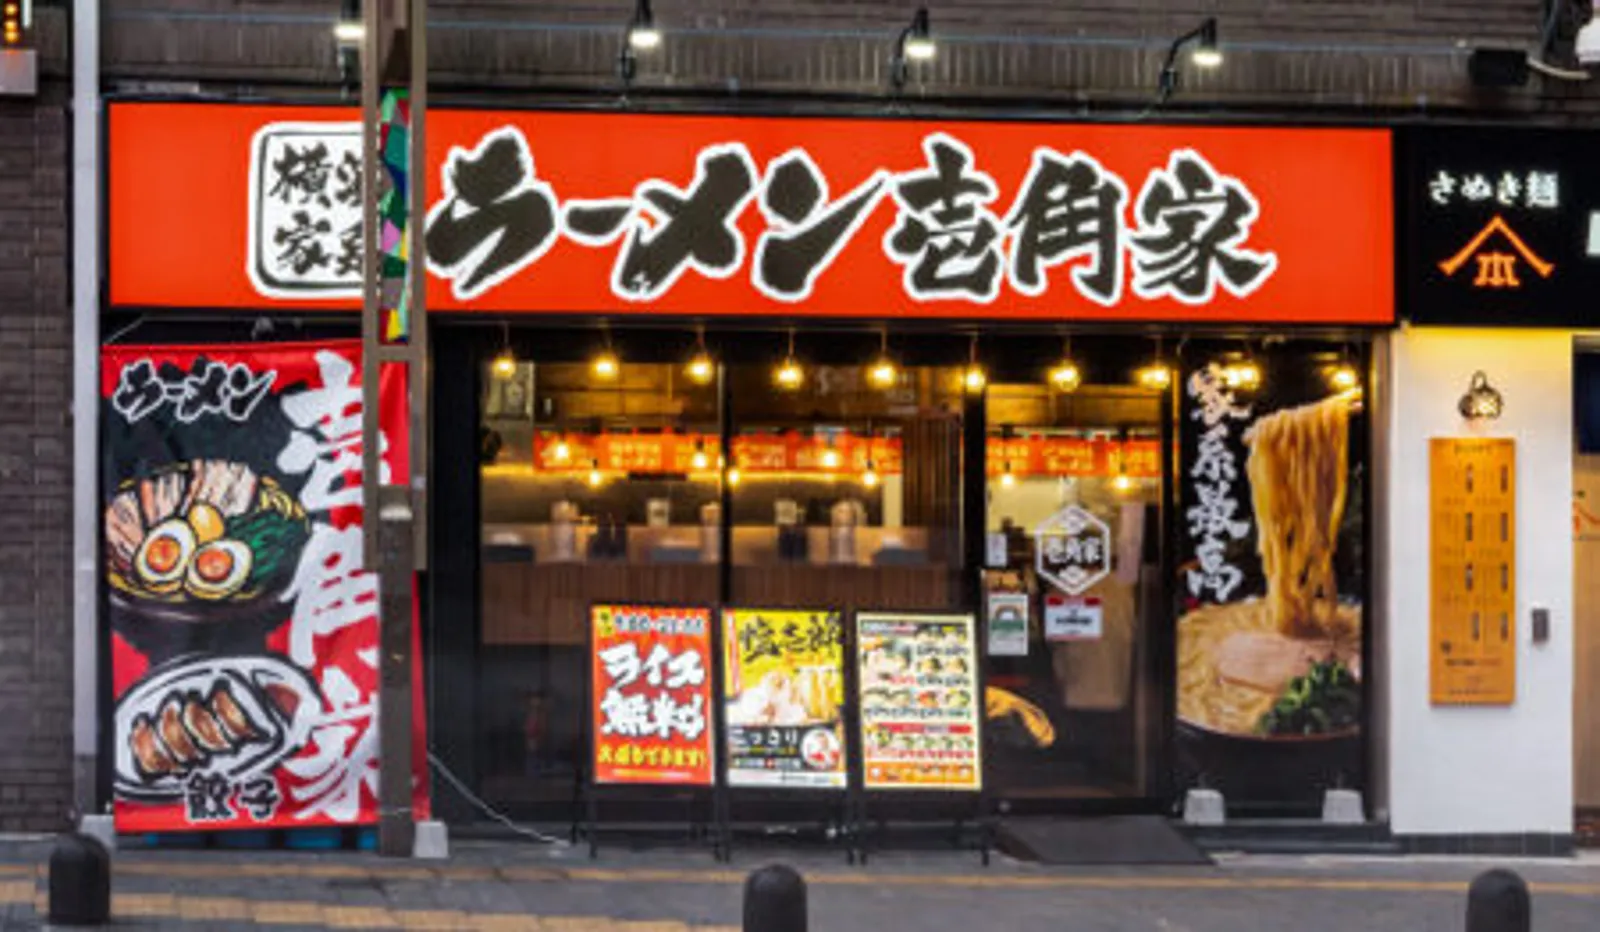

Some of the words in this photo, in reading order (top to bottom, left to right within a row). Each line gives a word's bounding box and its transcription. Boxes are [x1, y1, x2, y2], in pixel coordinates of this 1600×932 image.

[113, 357, 279, 423] ラーメン
[598, 641, 705, 689] ライス
[600, 687, 705, 740] 無料
[185, 770, 284, 821] 餃子
